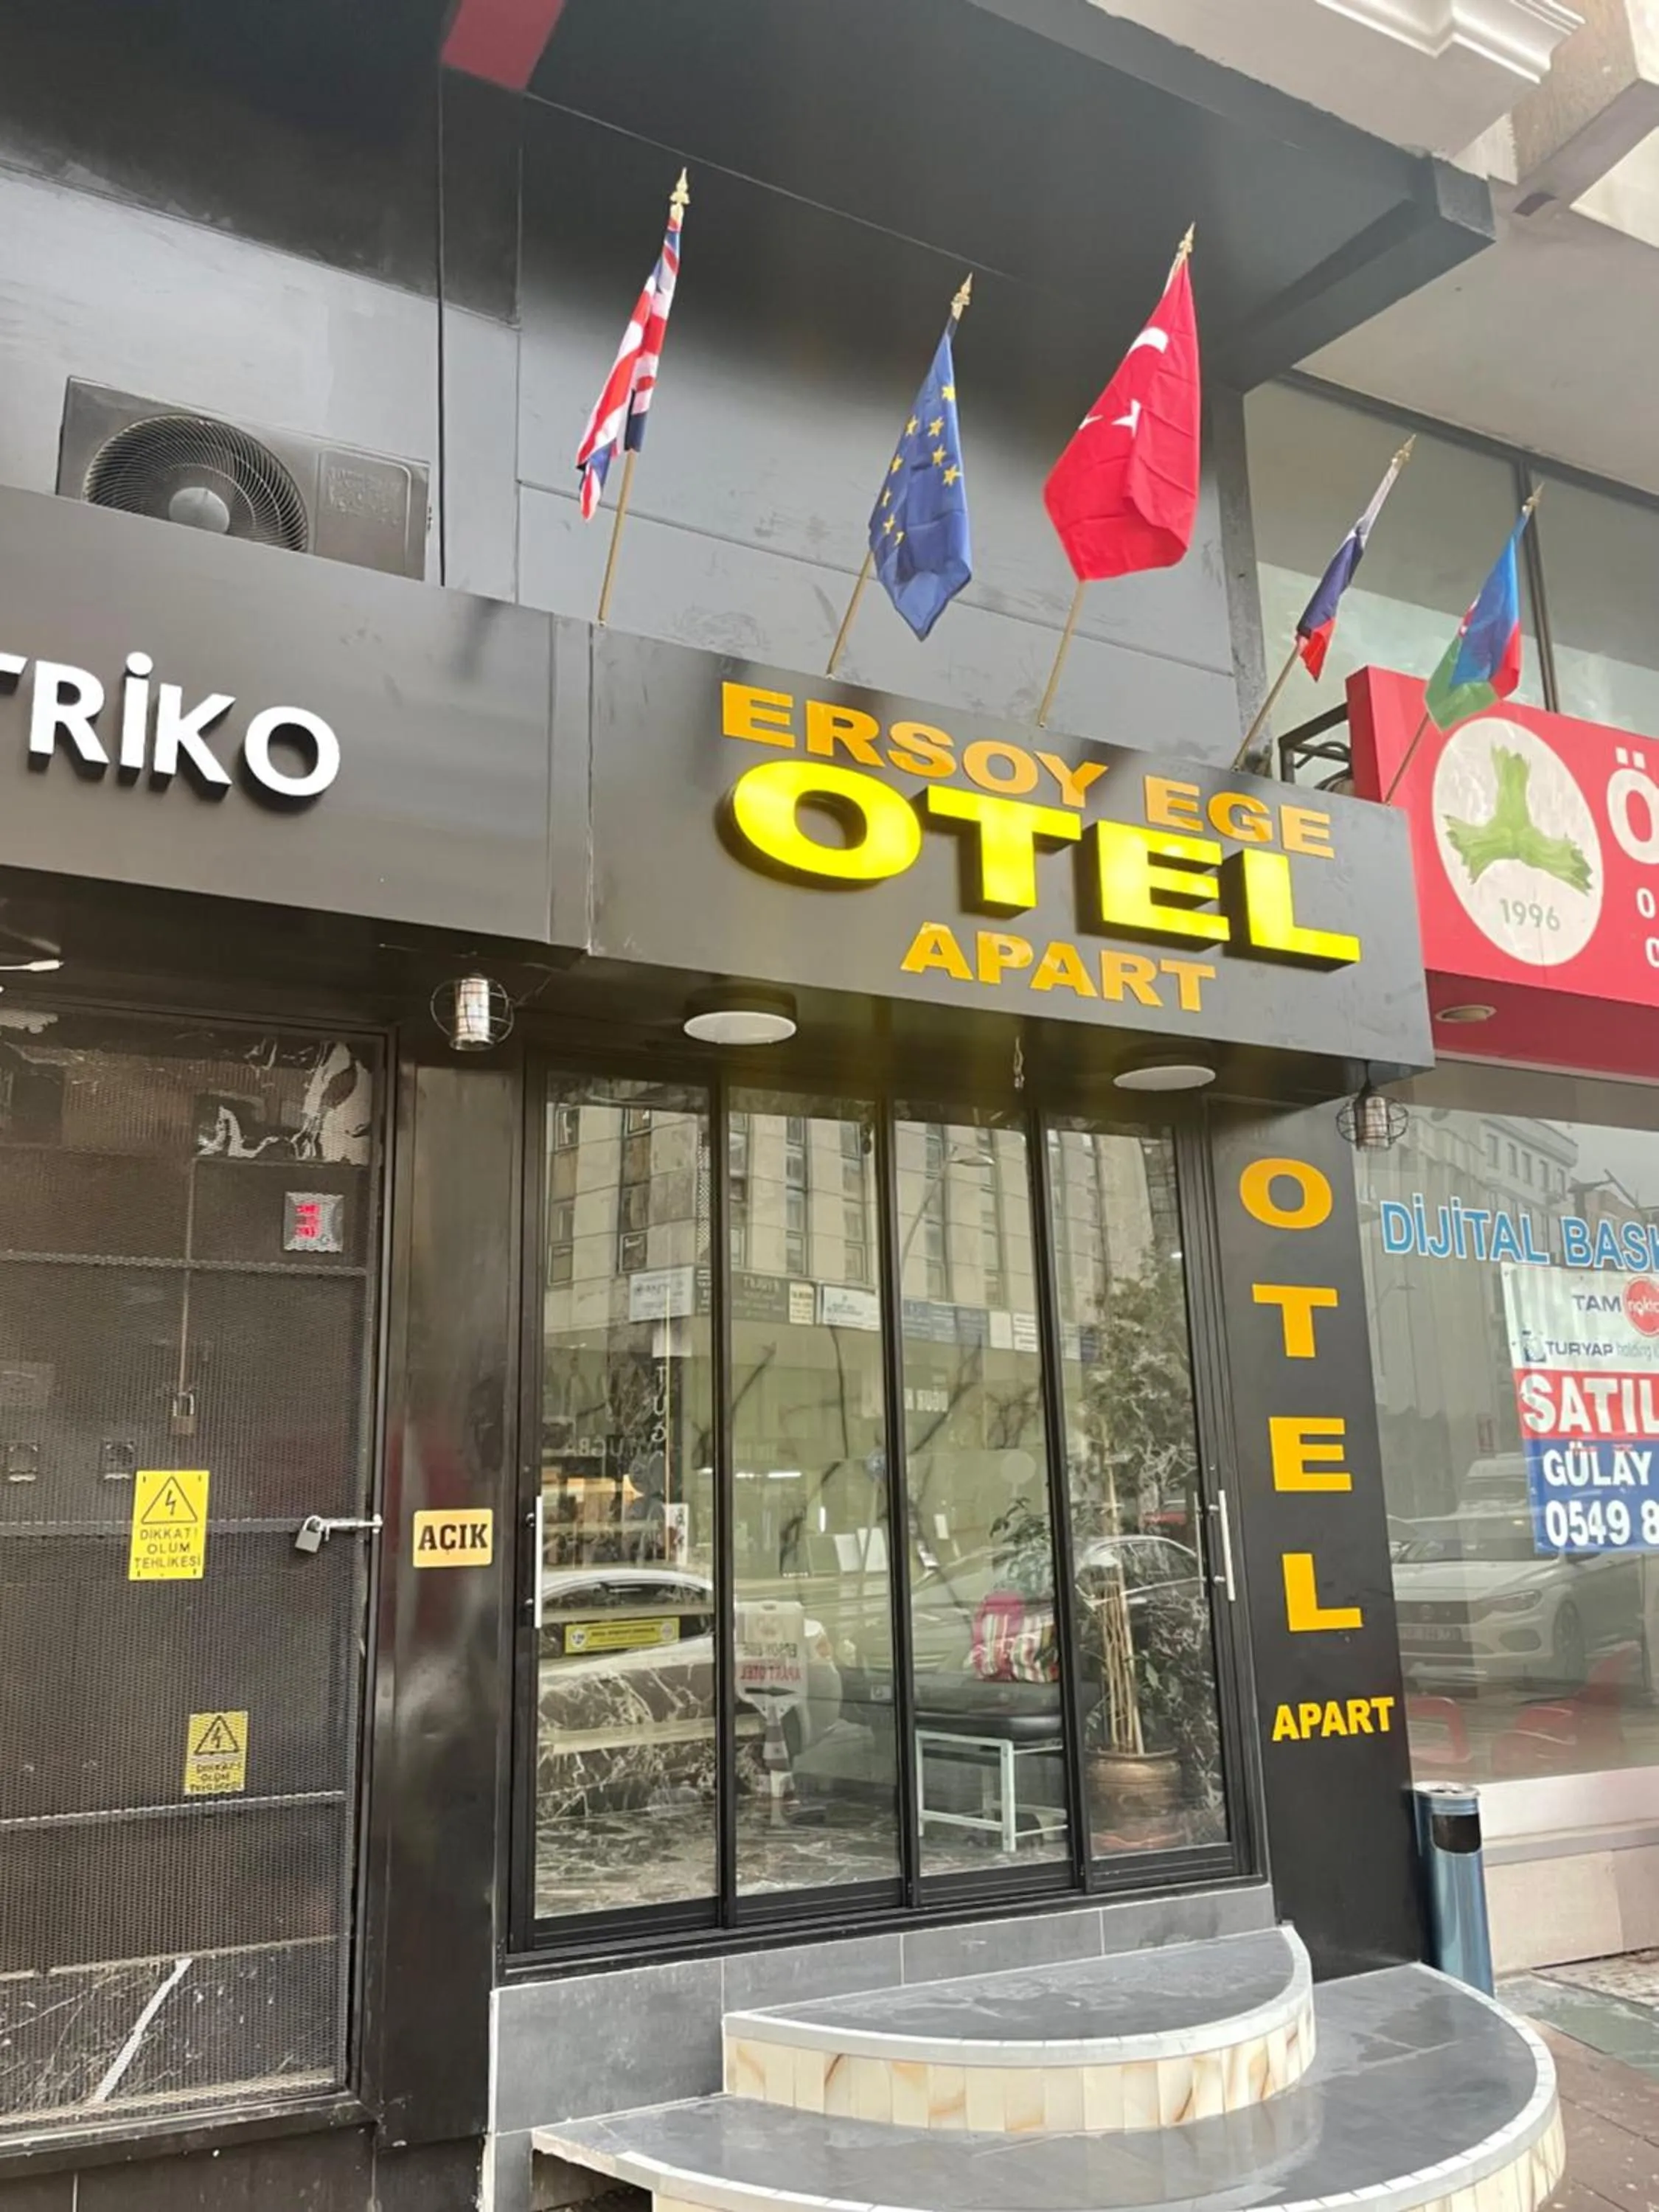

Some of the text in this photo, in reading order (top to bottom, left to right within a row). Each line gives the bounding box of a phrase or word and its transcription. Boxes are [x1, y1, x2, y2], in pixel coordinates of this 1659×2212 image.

[722, 681, 1336, 859] ERSOY EGE
[732, 757, 1361, 963] OTEL
[1499, 898, 1561, 931] 1996
[900, 920, 1217, 1012] APART
[1380, 1193, 1550, 1265] DİJİTAL
[1572, 1295, 1621, 1312] TAM
[1545, 1340, 1613, 1356] TURYAP
[1239, 1157, 1363, 1632] OTEL
[1519, 1373, 1659, 1434] SATIL
[1543, 1441, 1652, 1486] GÜLAY
[1545, 1500, 1631, 1547] 0549
[1272, 1697, 1396, 1742] APART
